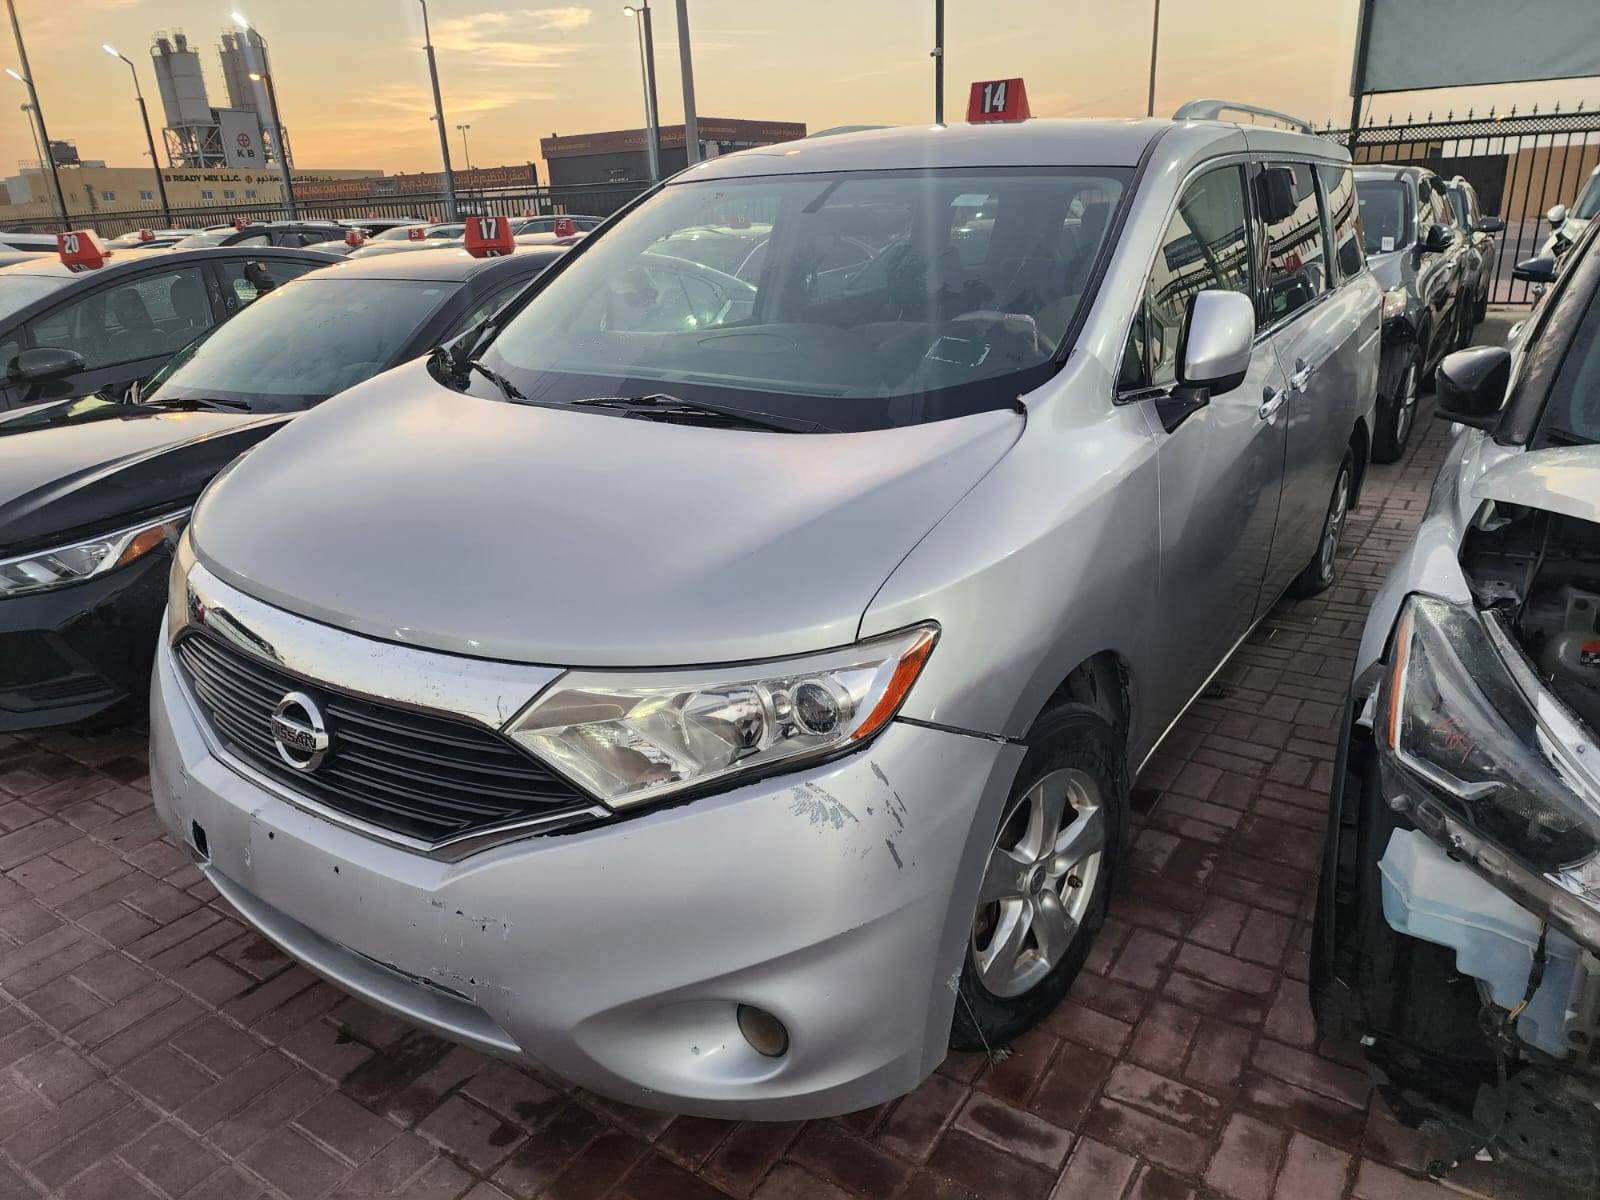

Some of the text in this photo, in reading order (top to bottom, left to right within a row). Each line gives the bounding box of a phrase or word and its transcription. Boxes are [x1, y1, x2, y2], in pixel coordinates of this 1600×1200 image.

[984, 81, 1006, 113] 14
[173, 174, 201, 182] READY
[203, 174, 219, 182] MIX
[479, 217, 497, 240] 17
[558, 220, 567, 230] 23
[63, 234, 80, 254] 20
[271, 720, 317, 749] NISSAN
